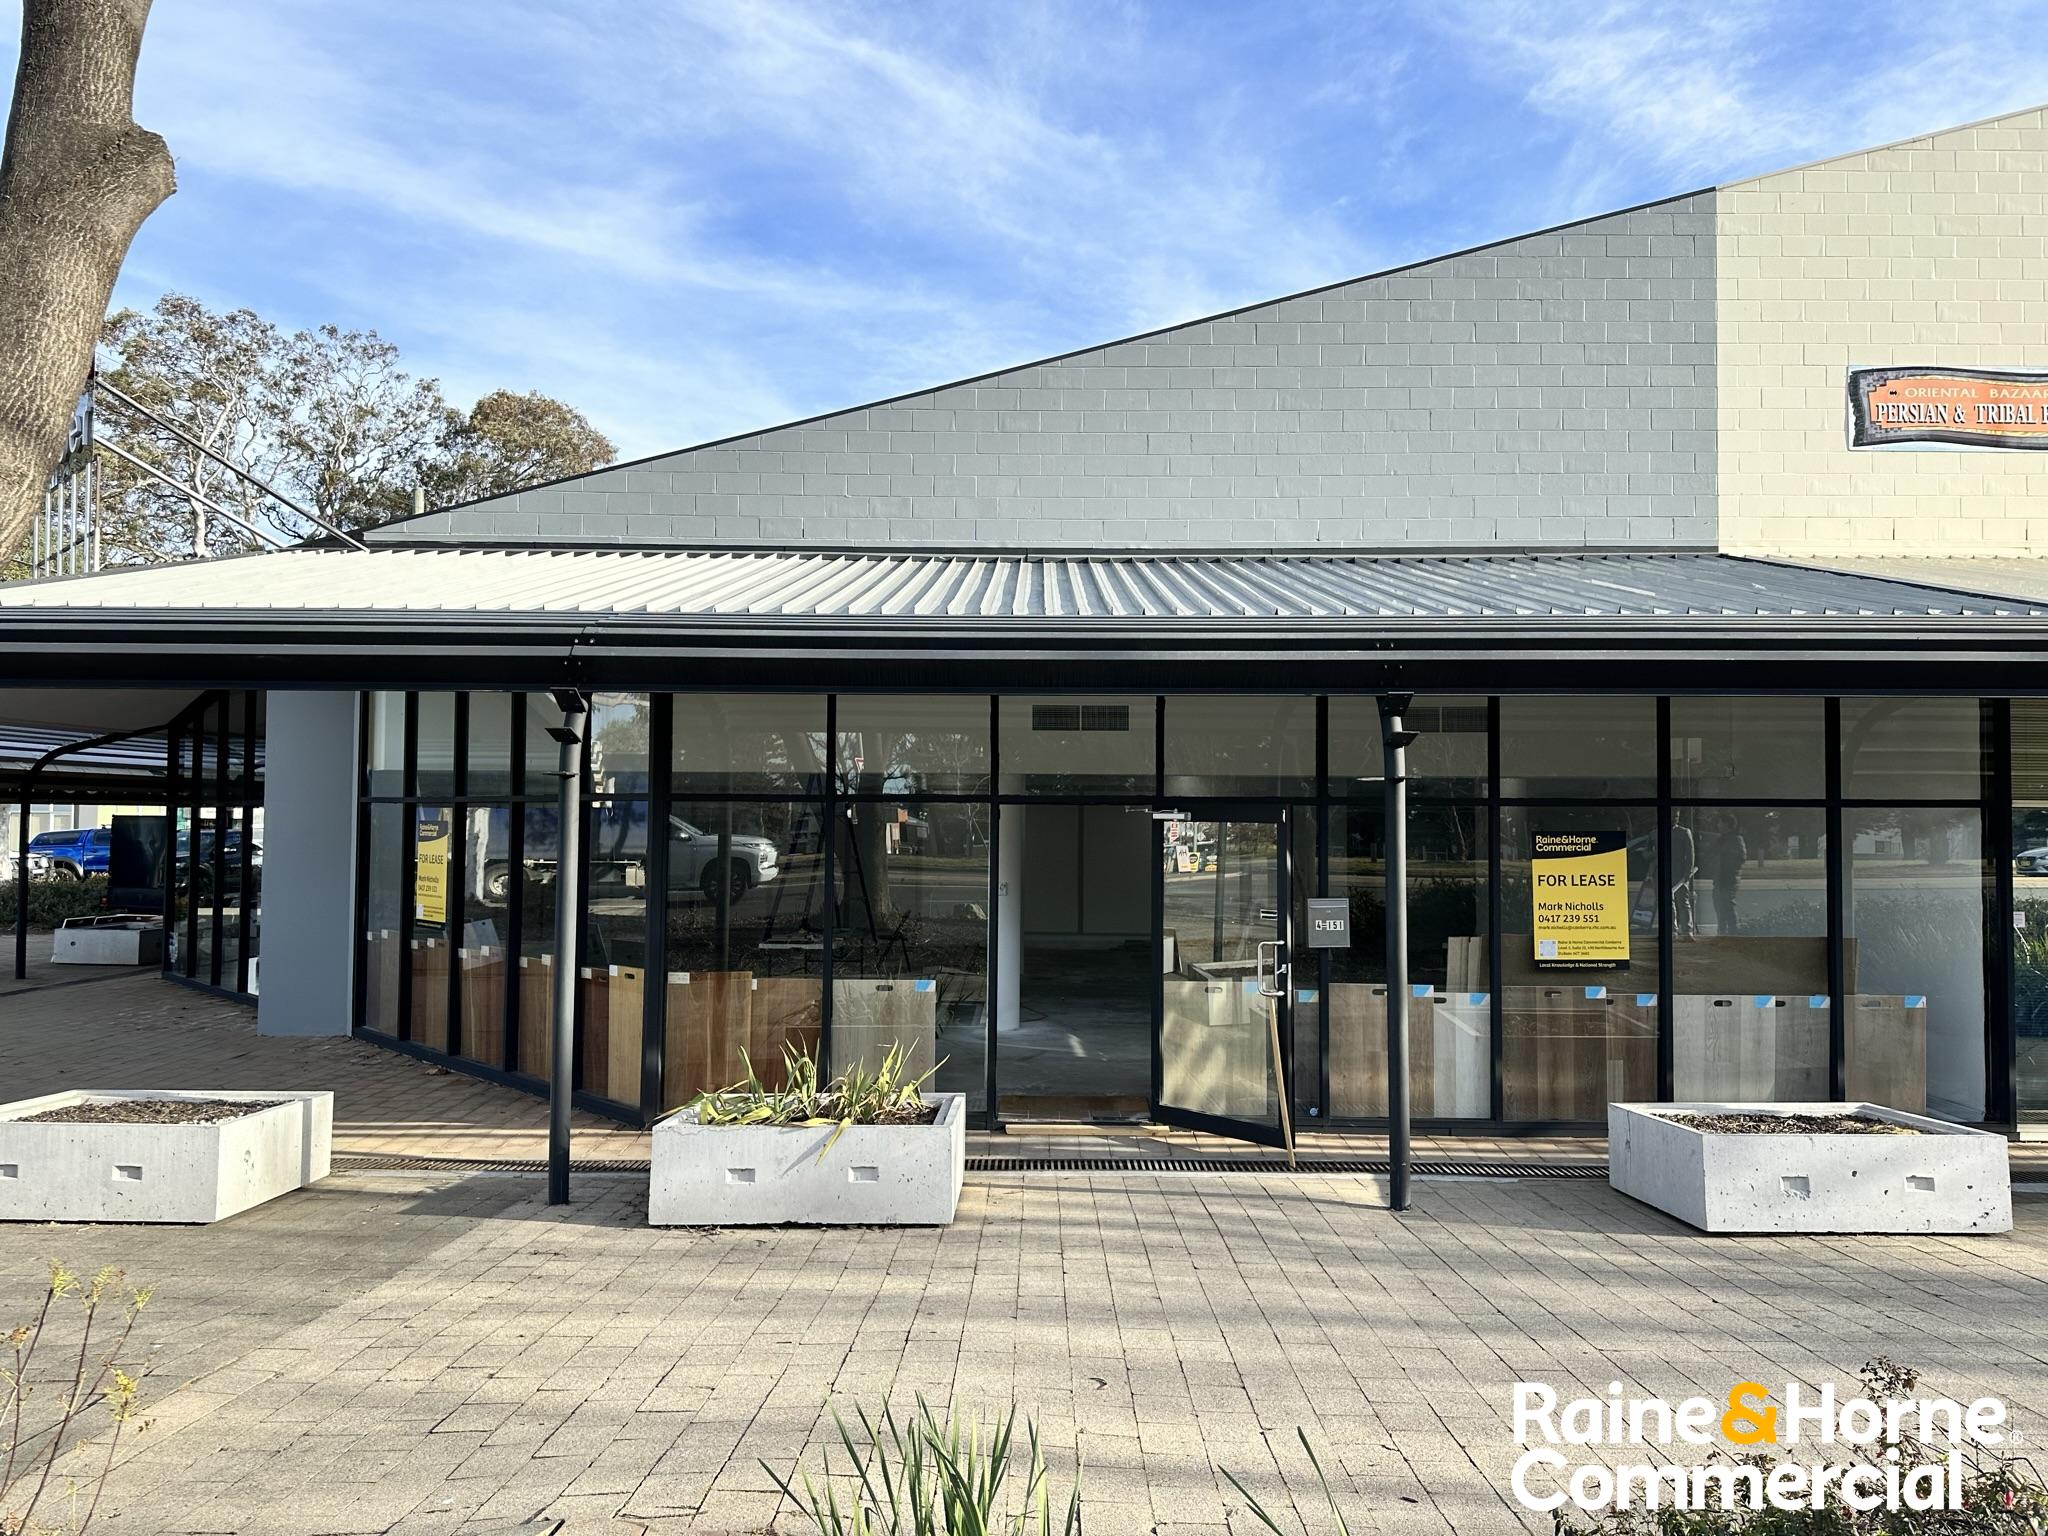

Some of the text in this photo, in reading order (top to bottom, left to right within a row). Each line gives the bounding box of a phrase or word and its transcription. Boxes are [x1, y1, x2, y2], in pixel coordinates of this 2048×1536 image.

[1905, 387, 1979, 399] ORIENTAL
[1875, 402, 1949, 424] PERSIAN
[1953, 404, 1966, 424] &
[1974, 403, 2038, 425] TRIBAL
[1535, 843, 1592, 852] Commercial
[429, 854, 444, 865] LEASE
[1537, 874, 1616, 887] FOR LEASE
[1538, 902, 1605, 911] Mark Nicholls
[1538, 914, 1600, 923] 0417 239 551
